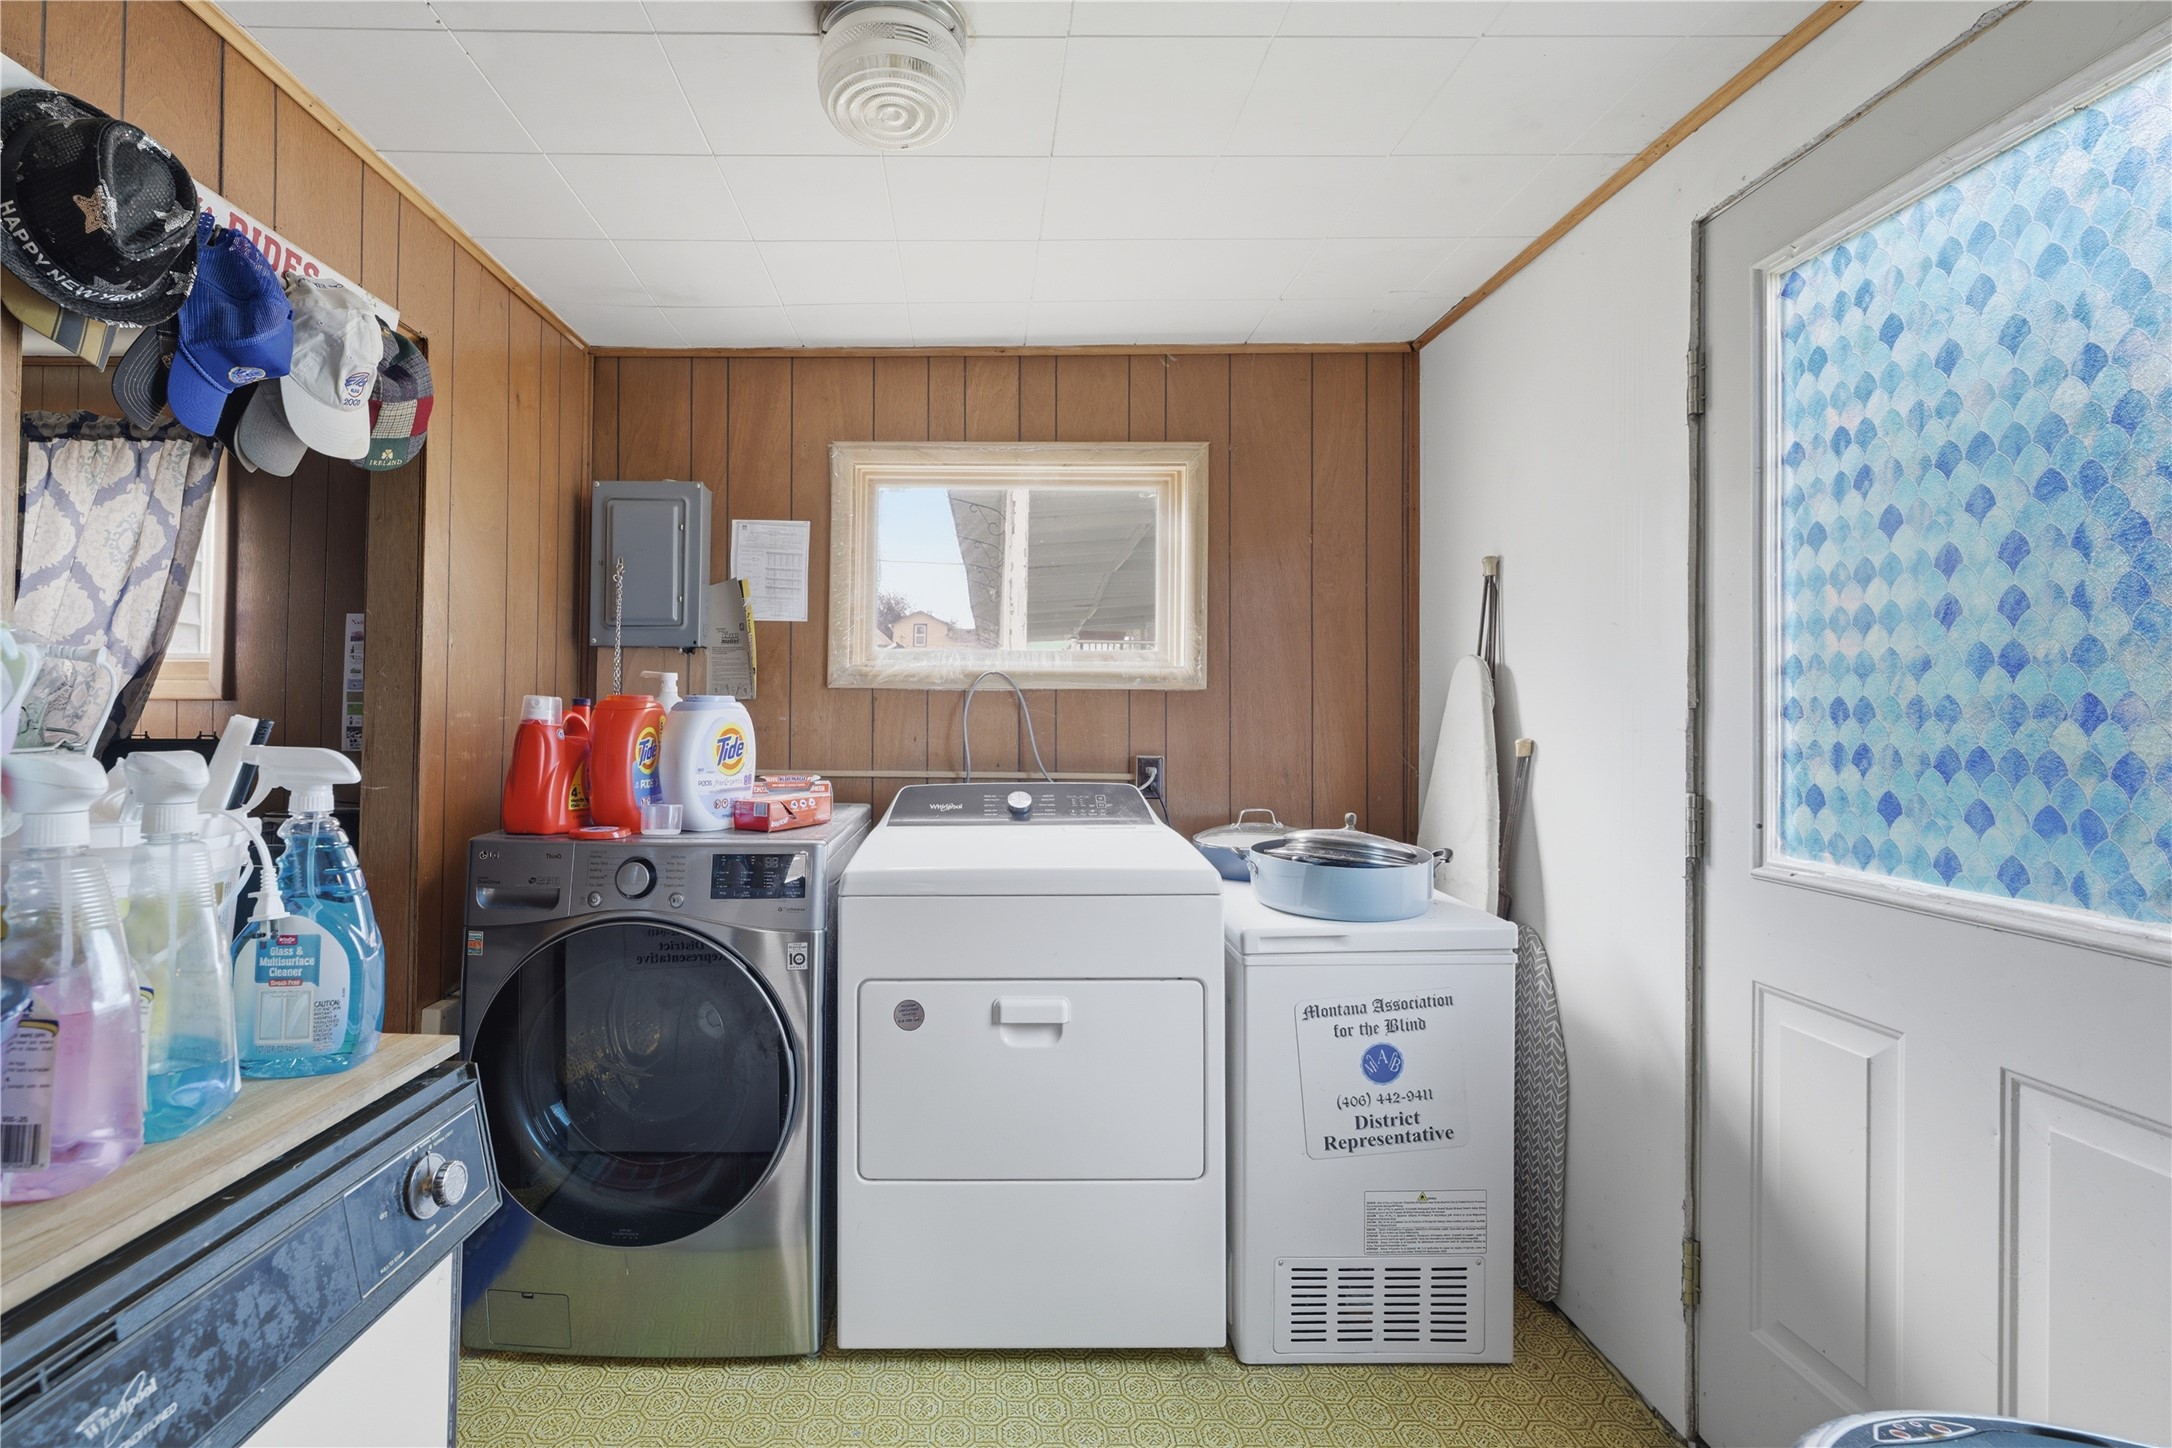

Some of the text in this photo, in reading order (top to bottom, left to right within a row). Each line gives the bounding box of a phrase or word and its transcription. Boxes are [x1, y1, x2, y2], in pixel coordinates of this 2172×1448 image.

[1, 200, 51, 266] HAPPY
[46, 268, 100, 299] NEW
[369, 458, 403, 467] IRELAND
[639, 738, 657, 766] Tide
[717, 735, 745, 767] Tide
[929, 802, 963, 812] Whirlpool
[269, 946, 304, 956] Glass &
[259, 957, 316, 967] Multisurface
[268, 967, 303, 978] Cleaner
[1301, 994, 1454, 1021] Montana Association
[1333, 1017, 1427, 1038] for the Blind
[1336, 1088, 1434, 1110] (406) 442-9411
[1354, 1111, 1421, 1131] District
[1323, 1126, 1455, 1153] Representative
[75, 1370, 158, 1448] Whirlpool
